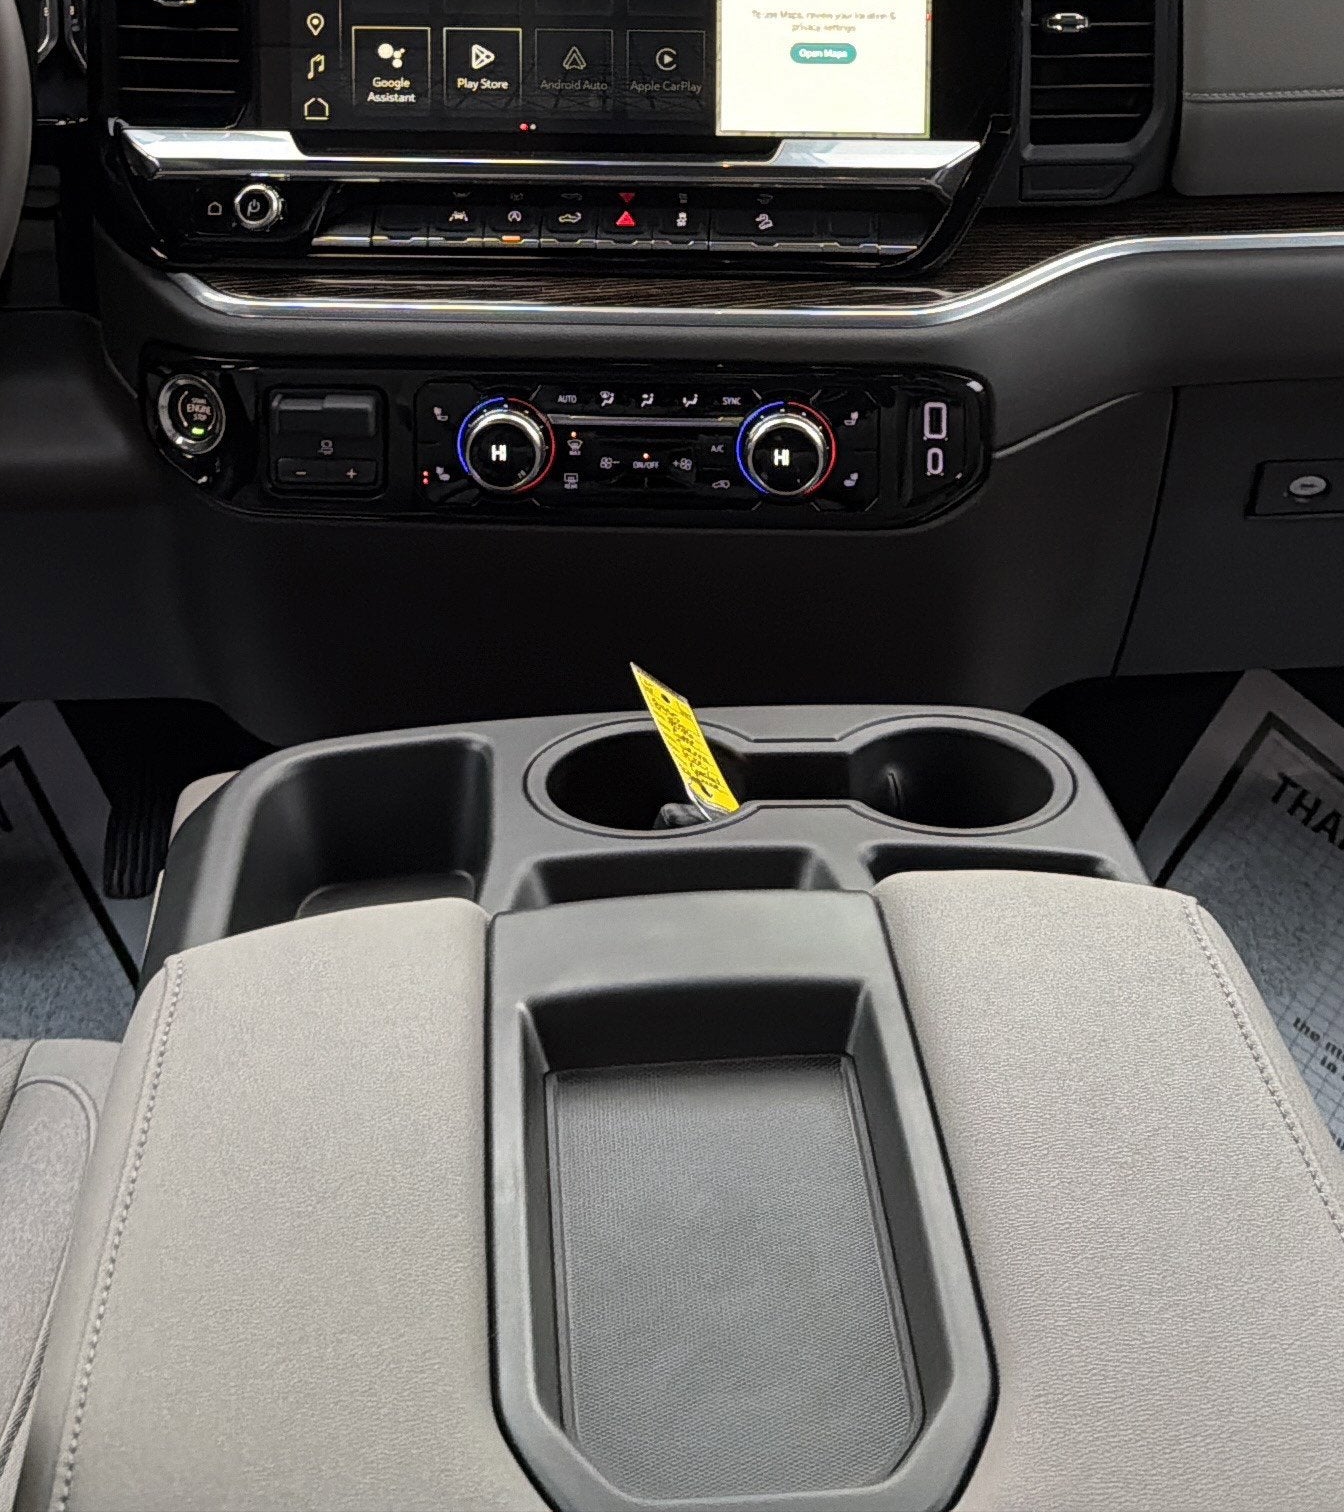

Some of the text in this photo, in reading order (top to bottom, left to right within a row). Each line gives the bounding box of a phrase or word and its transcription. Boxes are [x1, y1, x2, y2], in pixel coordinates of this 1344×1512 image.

[372, 76, 411, 90] Google
[457, 77, 510, 91] Play Store
[540, 78, 609, 91] Android Auto
[630, 80, 703, 94] Apple CarPlay
[367, 90, 416, 104] Assistant
[556, 394, 578, 405] AUTO
[721, 396, 742, 406] SYNC
[490, 444, 507, 463] HI
[710, 444, 725, 454] A/C
[773, 449, 790, 467] HI
[632, 460, 660, 471] ON/OFF
[1292, 1016, 1321, 1043] the
[1320, 1055, 1338, 1074] in
